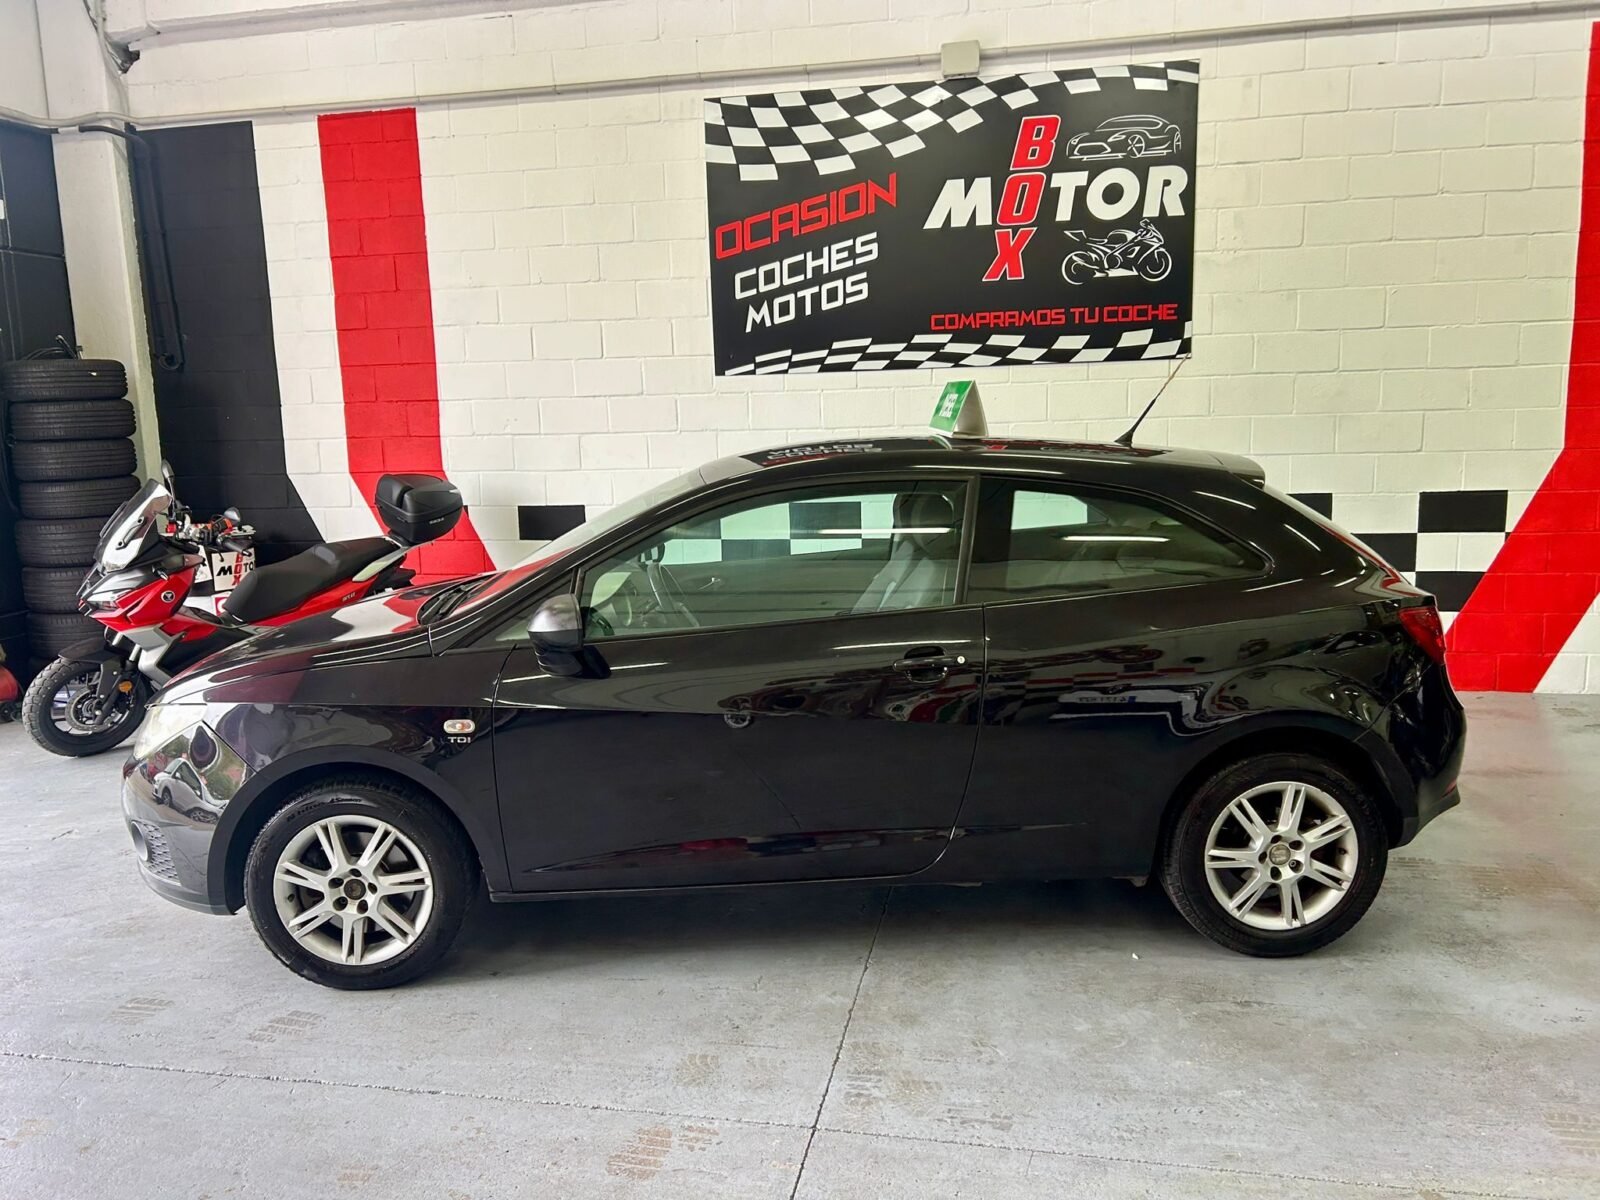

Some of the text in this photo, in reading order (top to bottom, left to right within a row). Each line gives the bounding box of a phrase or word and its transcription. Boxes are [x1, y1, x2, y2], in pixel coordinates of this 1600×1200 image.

[715, 172, 897, 260] OCASION
[923, 165, 1188, 230] MOTOR
[982, 115, 1061, 281] BOX
[735, 232, 878, 300] COCHES
[745, 272, 869, 333] MOTOS
[930, 303, 1178, 330] COMPRAMOS TU COCHE
[447, 736, 471, 744] TDI
